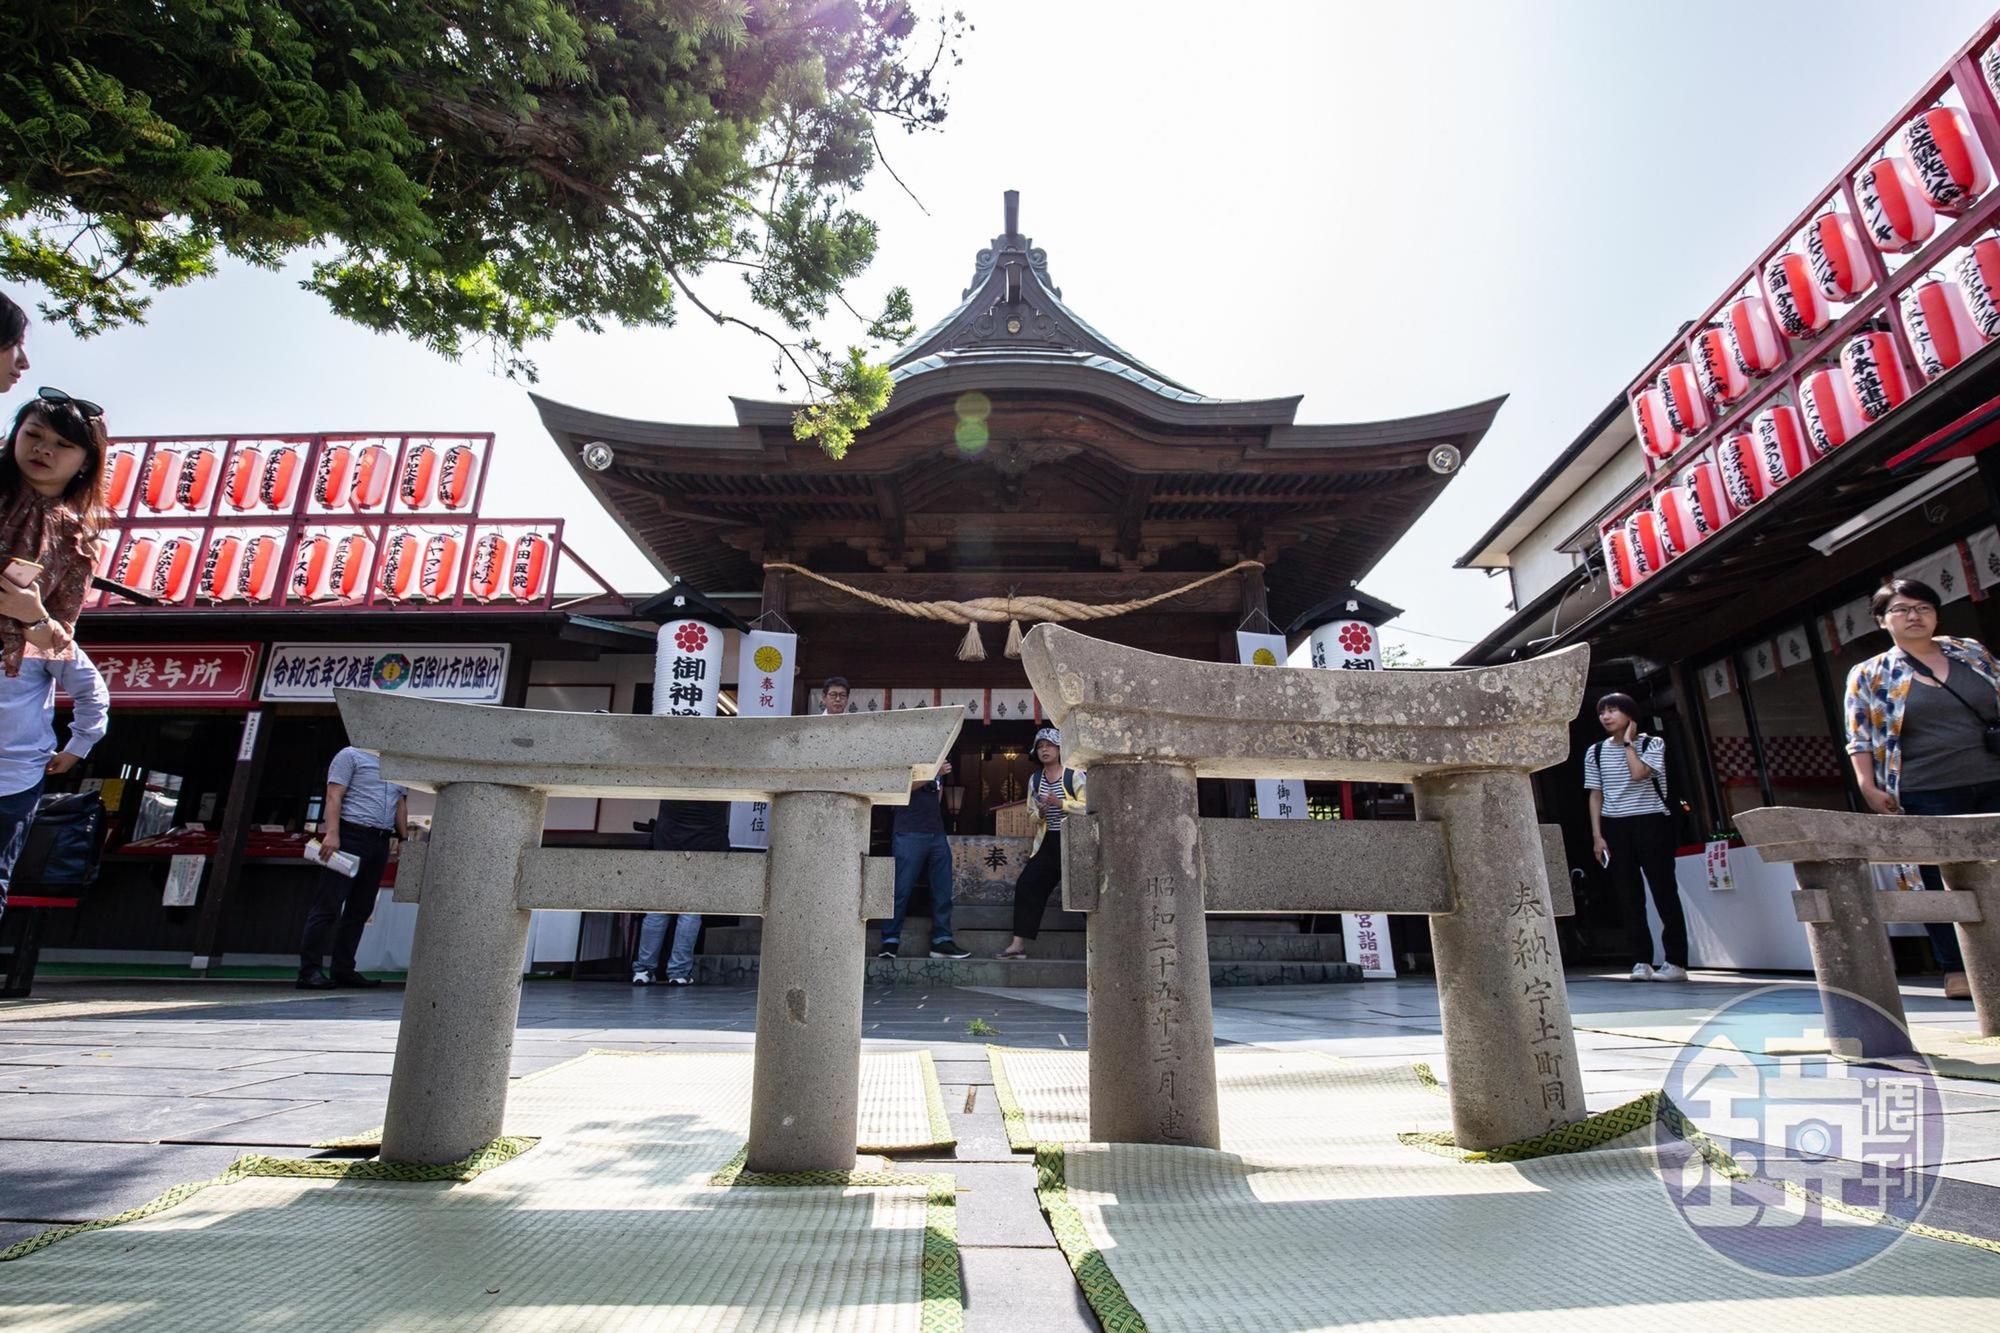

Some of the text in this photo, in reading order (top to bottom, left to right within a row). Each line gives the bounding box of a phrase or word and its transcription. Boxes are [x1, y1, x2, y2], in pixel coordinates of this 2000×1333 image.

[760, 677, 775, 708] 奉祝
[1277, 779, 1293, 819] 御即
[984, 846, 1008, 872] 奉
[1145, 875, 1187, 1140] 昭和二十五年三月建
